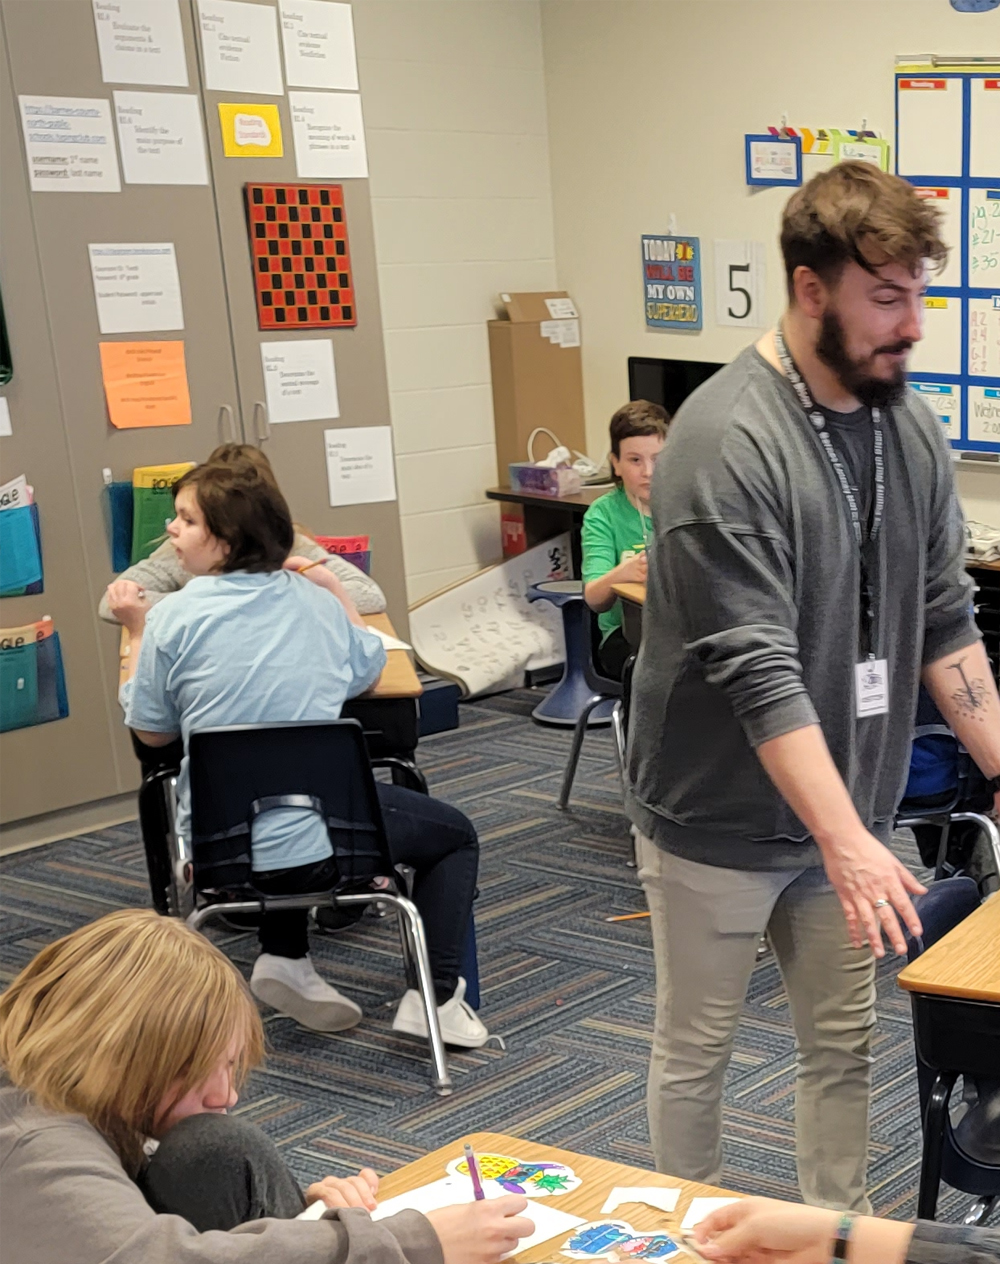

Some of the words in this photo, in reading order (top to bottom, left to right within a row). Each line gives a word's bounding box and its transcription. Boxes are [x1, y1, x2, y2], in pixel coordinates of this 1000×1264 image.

[642, 239, 676, 262] TODAY
[646, 263, 675, 282] WILL
[677, 265, 694, 282] BE
[646, 284, 665, 299] MY
[666, 285, 695, 301] OWN
[728, 263, 752, 319] 5
